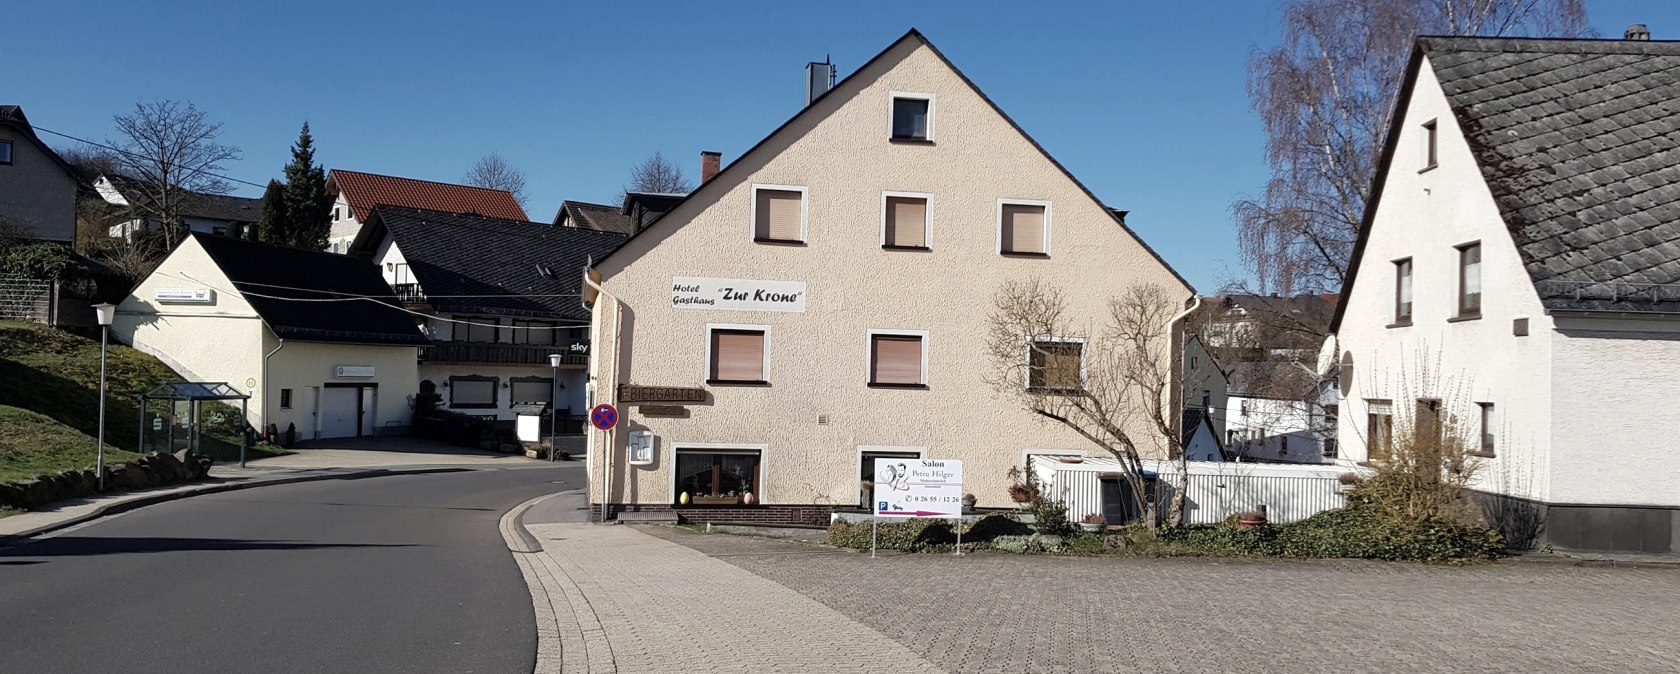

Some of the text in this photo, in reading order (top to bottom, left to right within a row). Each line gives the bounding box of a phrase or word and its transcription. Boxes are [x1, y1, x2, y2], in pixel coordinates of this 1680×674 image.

[673, 284, 700, 293] Hotel
[673, 295, 715, 306] Gasthaus
[571, 342, 588, 353] sky
[630, 387, 702, 400] BIERGARTEN
